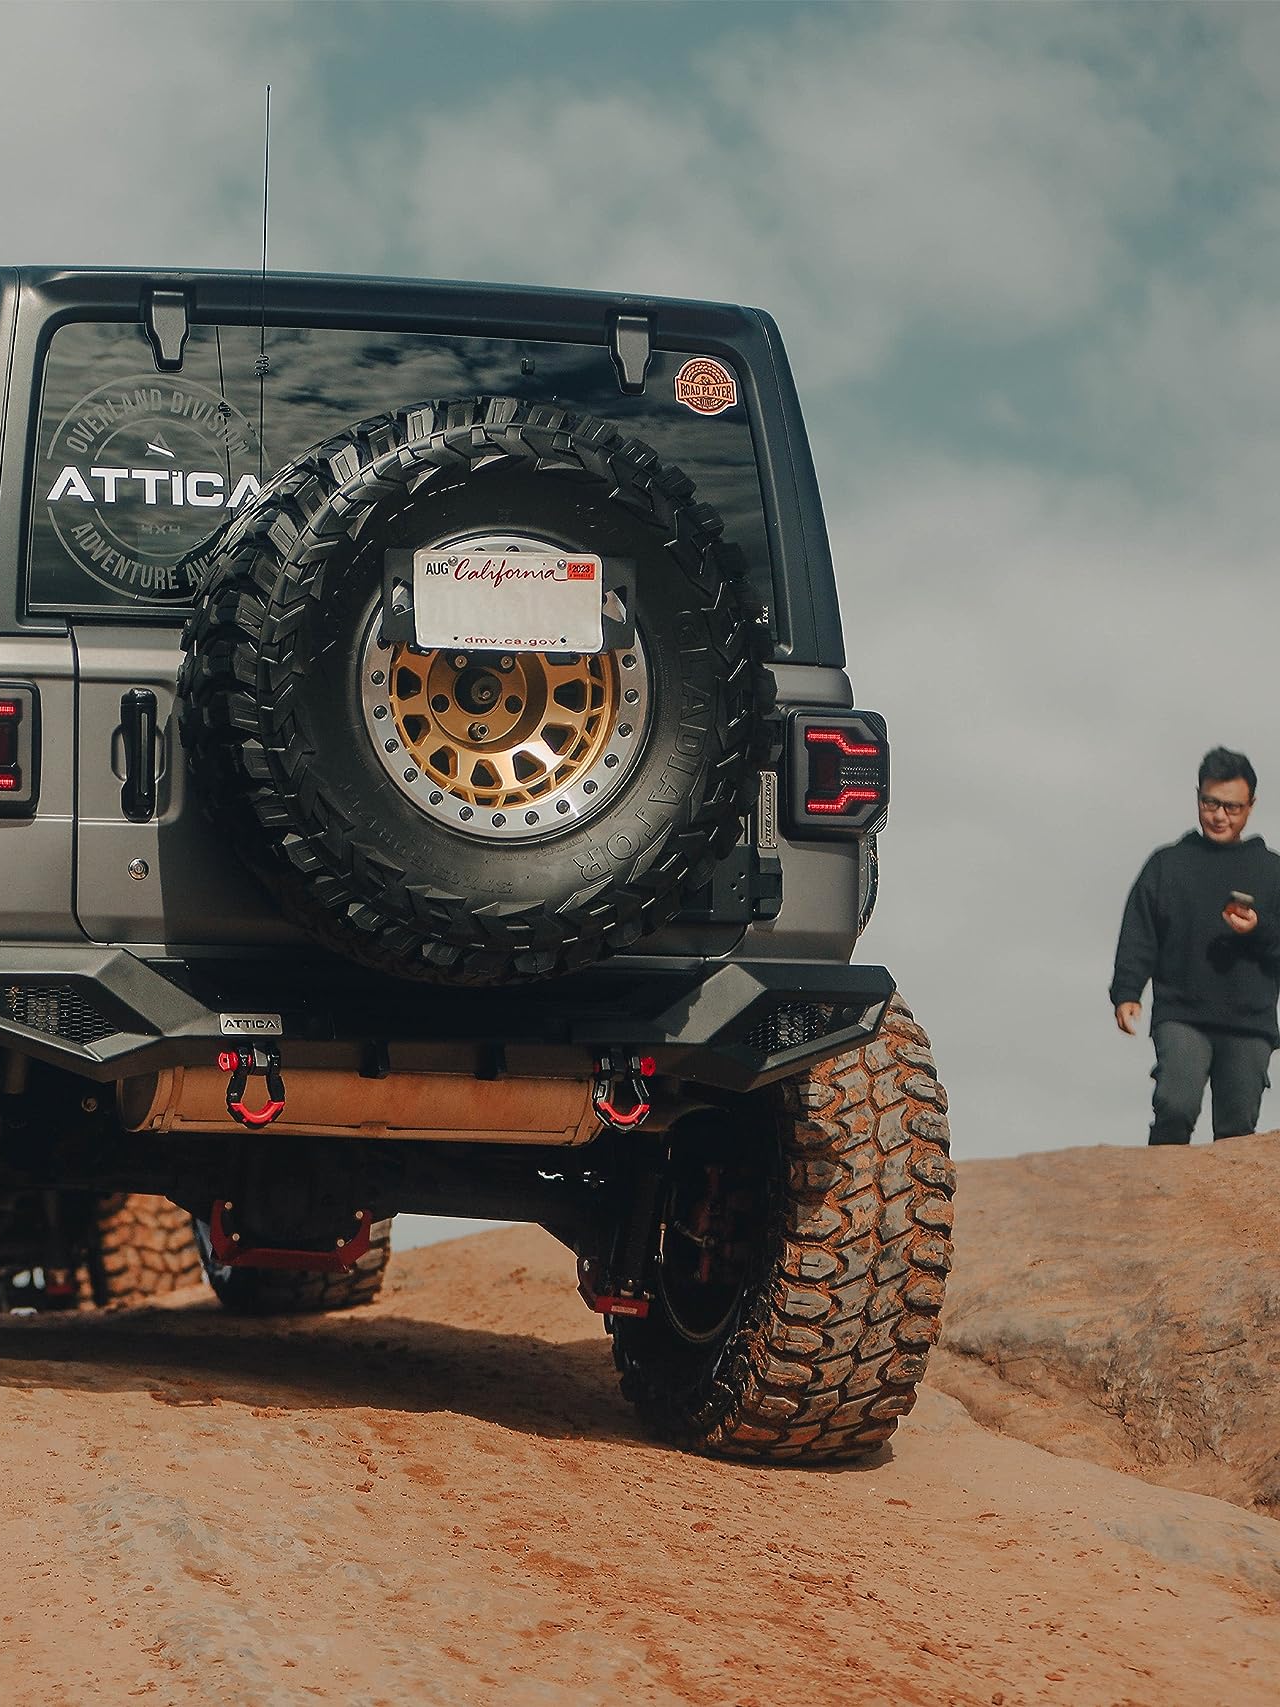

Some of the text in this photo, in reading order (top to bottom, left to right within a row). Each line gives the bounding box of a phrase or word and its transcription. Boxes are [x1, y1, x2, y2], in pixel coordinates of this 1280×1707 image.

[680, 383, 732, 399] ROAD PLAYER
[66, 388, 162, 454] OVERLAND
[71, 522, 179, 590] ADVENTURE
[425, 561, 449, 576] AUG
[453, 558, 569, 588] California
[464, 635, 558, 647] dmv.ca.gov
[224, 1019, 276, 1029] ATTICA
